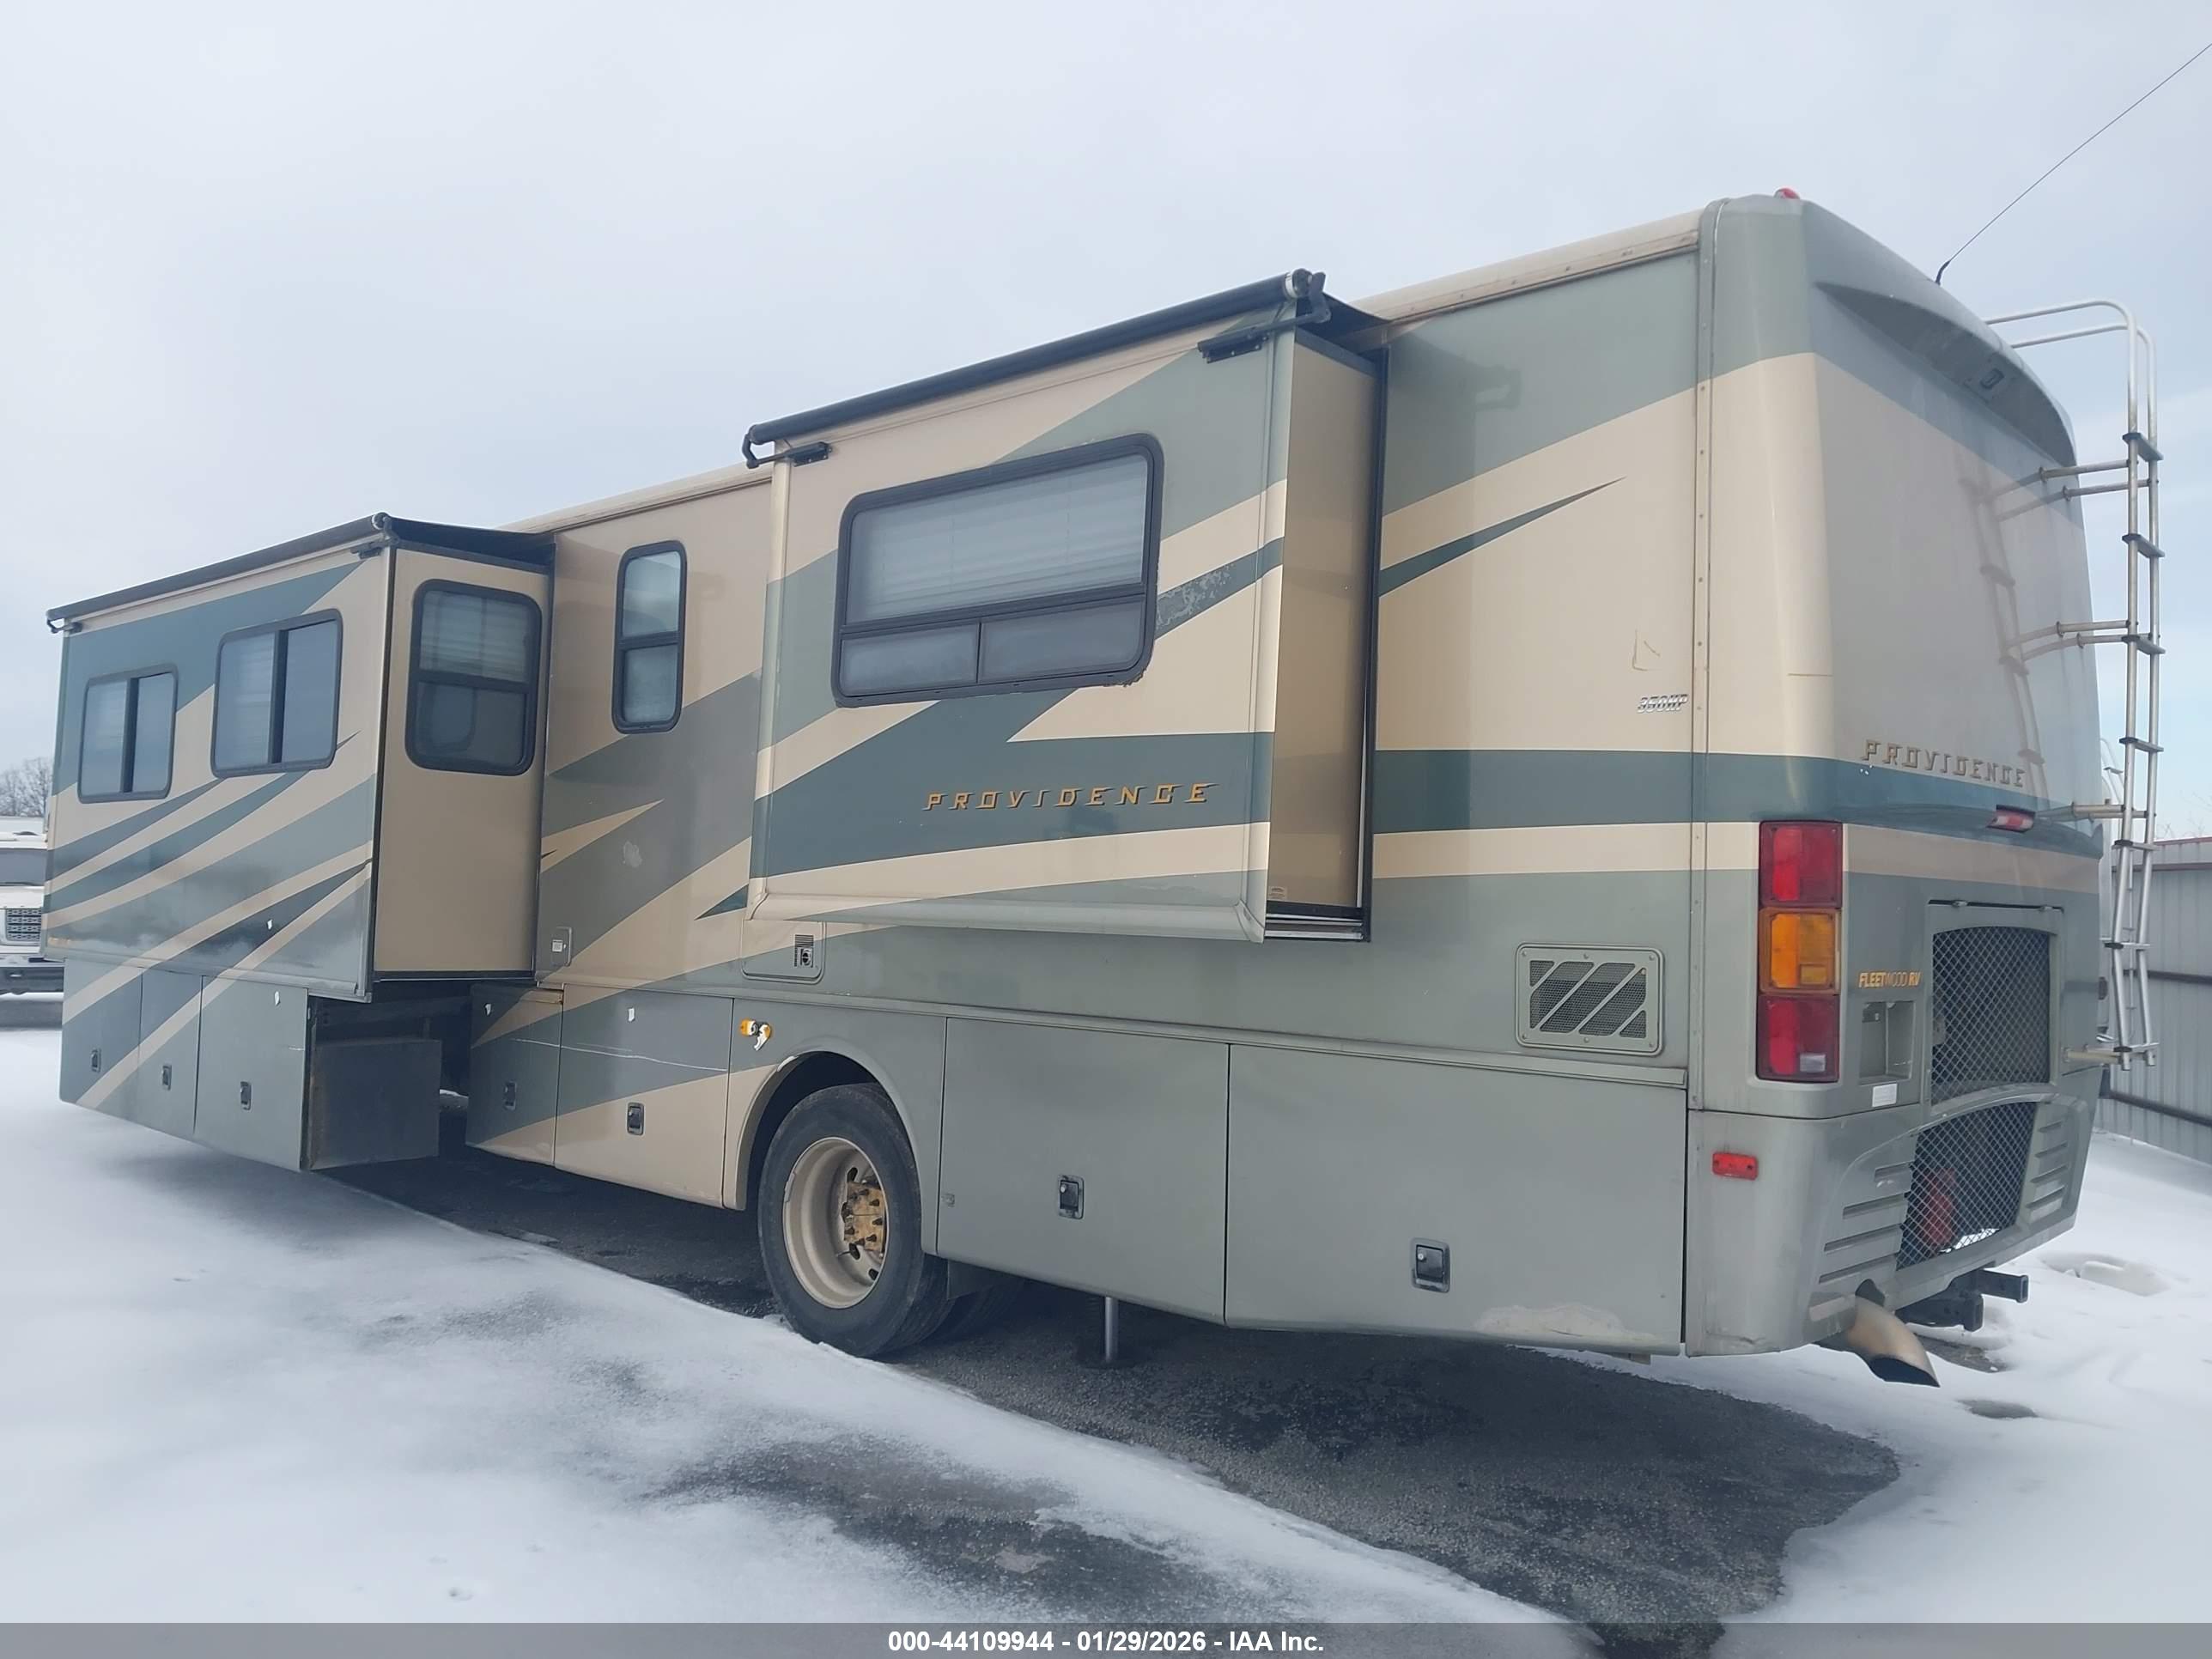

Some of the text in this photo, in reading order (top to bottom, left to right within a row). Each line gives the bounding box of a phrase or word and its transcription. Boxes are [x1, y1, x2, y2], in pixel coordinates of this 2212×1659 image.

[1637, 694, 1688, 714] 350HP
[1860, 738, 2027, 787] PROVIDENCE
[922, 782, 1219, 811] PROVIDENCE
[1858, 970, 1922, 988] FLEETWOOD RV
